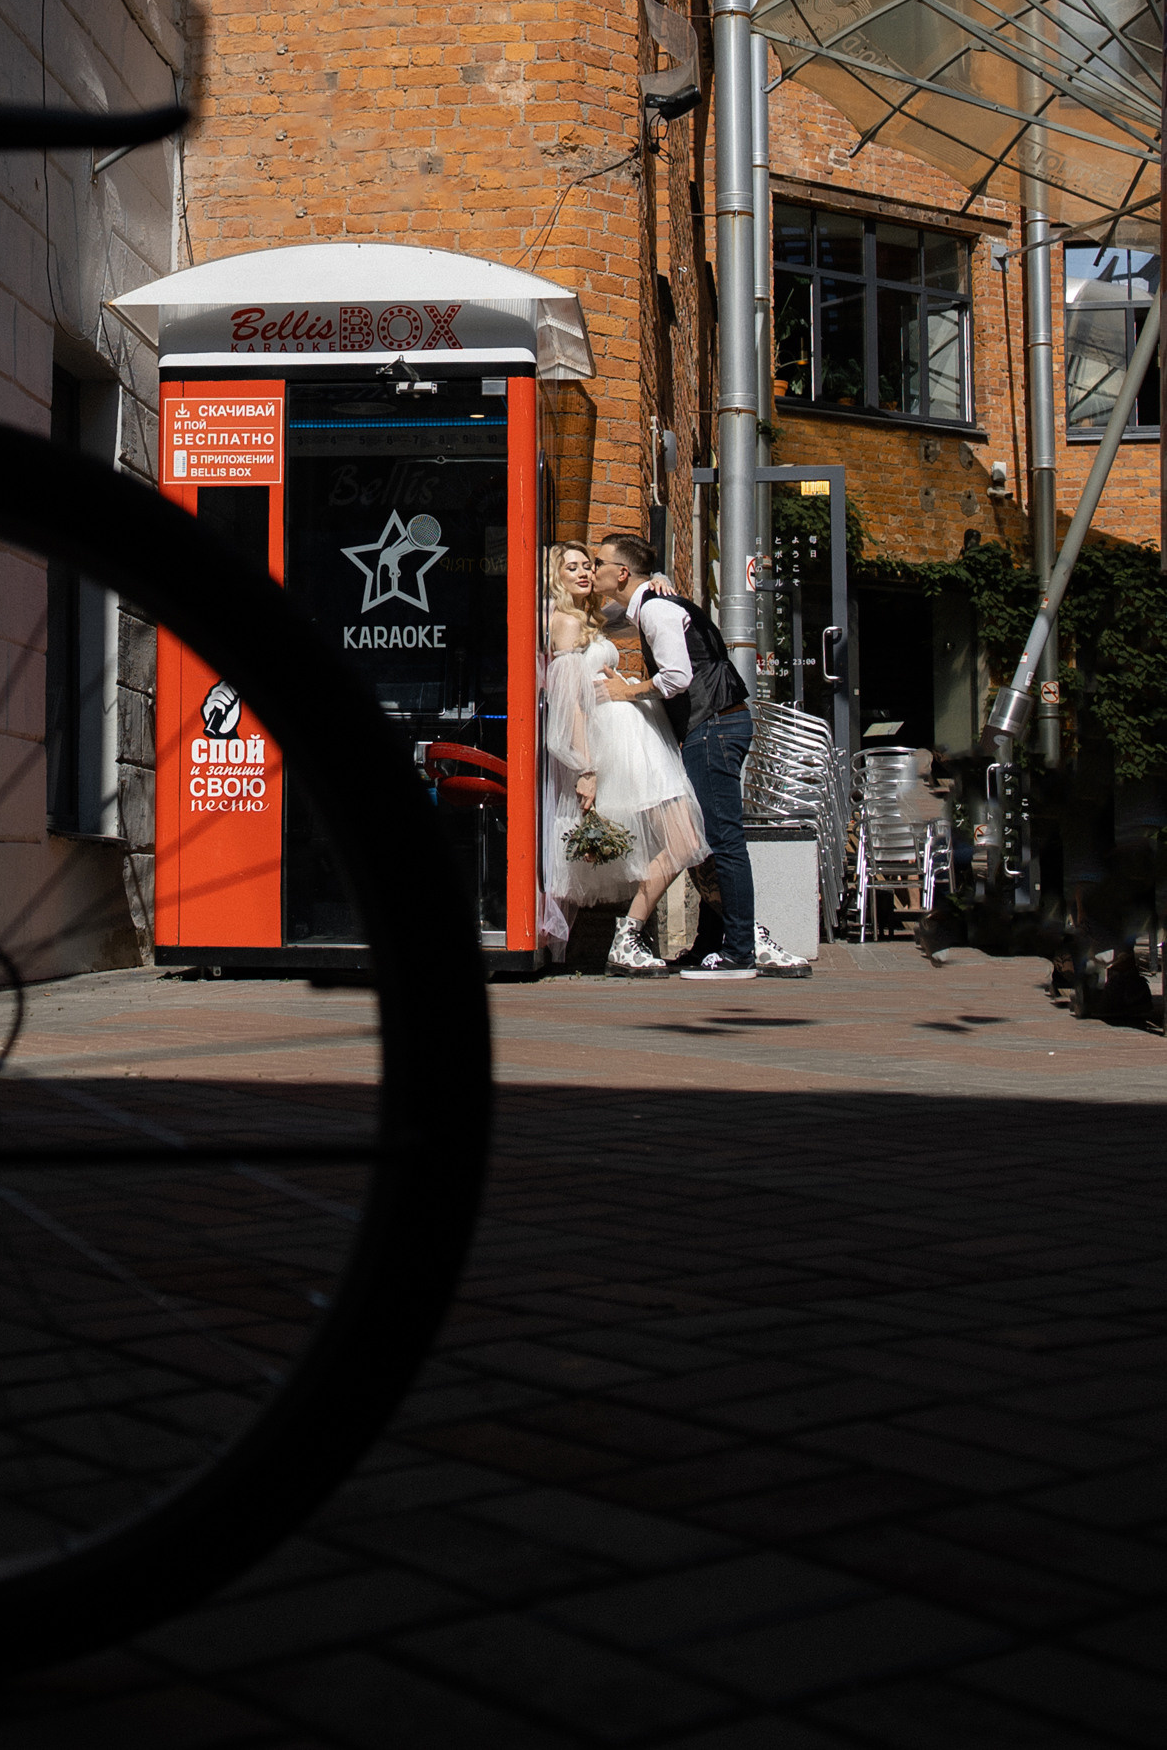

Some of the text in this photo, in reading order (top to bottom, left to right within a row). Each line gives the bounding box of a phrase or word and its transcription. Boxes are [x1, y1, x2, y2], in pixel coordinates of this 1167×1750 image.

[230, 304, 463, 351] Bellis BOX
[230, 341, 336, 353] KARAOKE
[198, 402, 275, 417] СКАЧИВАЙ
[174, 419, 207, 430] И ПОЙ
[173, 433, 275, 445] БЕСПЛАТНО
[190, 455, 274, 464] В ПРИЛОЖЕНИИ
[190, 468, 252, 477] BELLIS BOX
[791, 535, 801, 587] ようこそ
[343, 625, 446, 649] KARAOKE
[792, 658, 816, 666] 23:00
[191, 734, 265, 764] СПОЙ
[190, 765, 265, 776] и запиши
[190, 777, 266, 797] СВОЮ
[190, 799, 270, 812] песню
